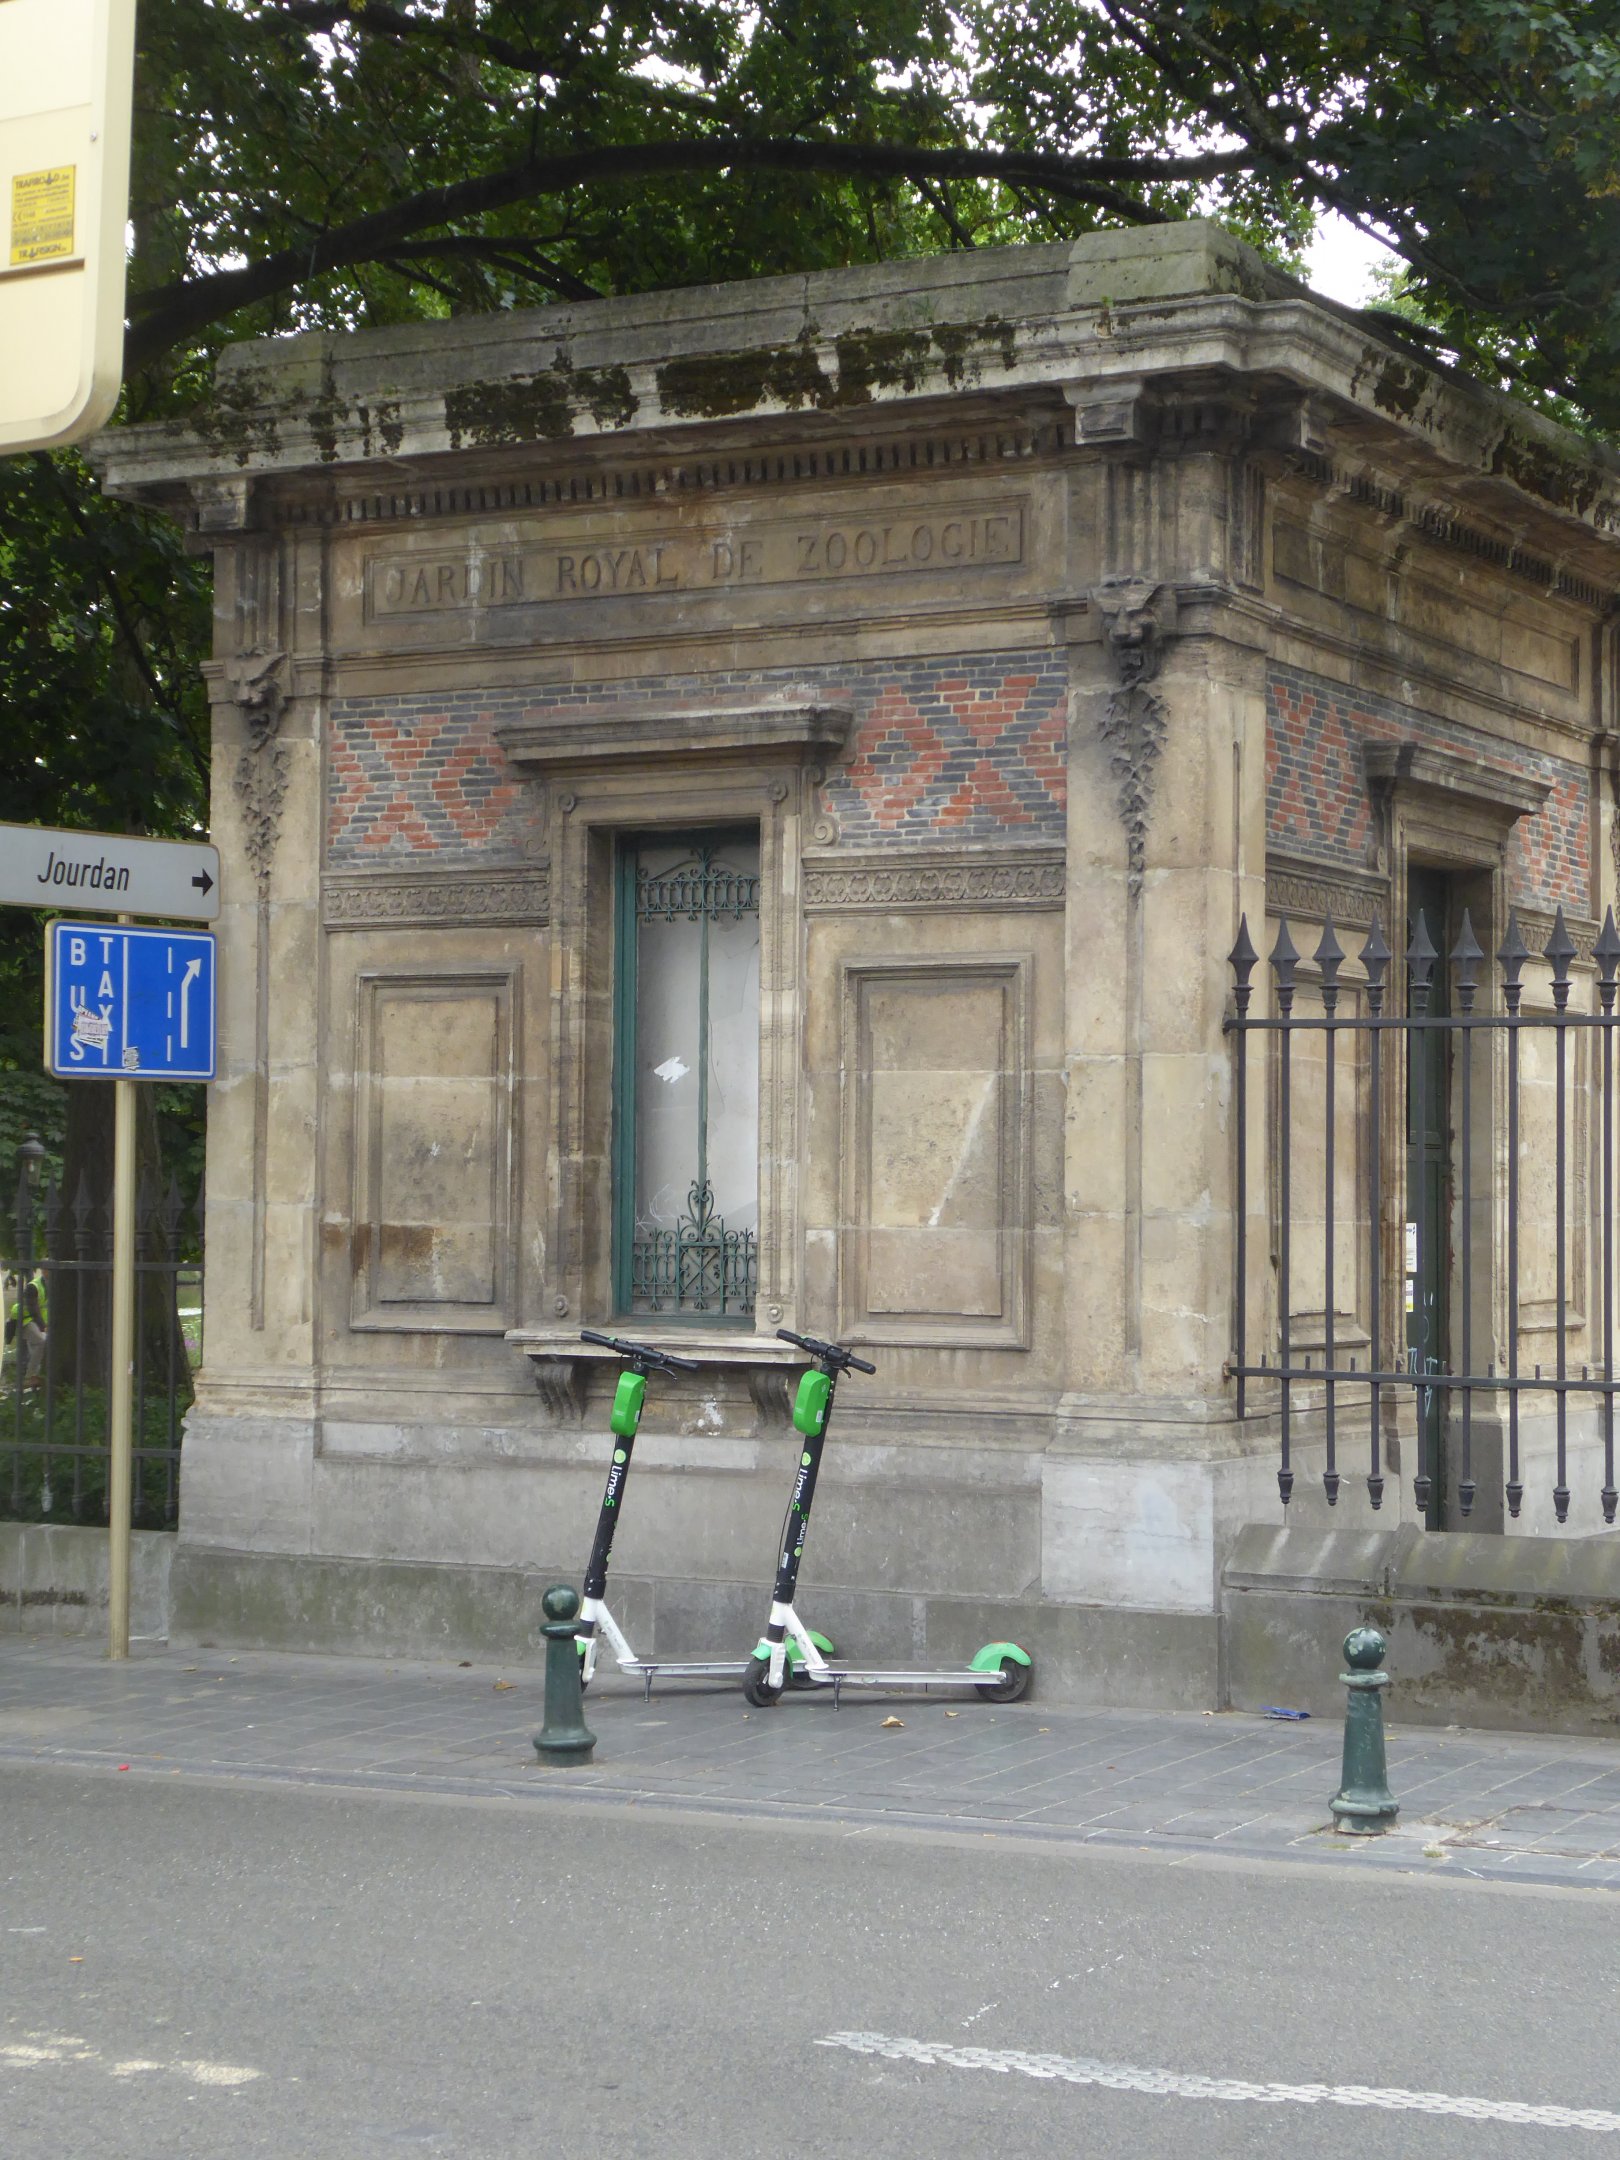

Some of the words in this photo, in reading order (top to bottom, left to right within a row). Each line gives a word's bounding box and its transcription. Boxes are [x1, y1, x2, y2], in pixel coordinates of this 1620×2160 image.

[556, 548, 679, 593] ROYAL
[711, 540, 763, 580] DE
[797, 516, 1009, 574] ZOOLOGIE
[37, 851, 130, 891] Jourdan
[69, 937, 86, 1061] BUS
[97, 936, 115, 1065] TAXI
